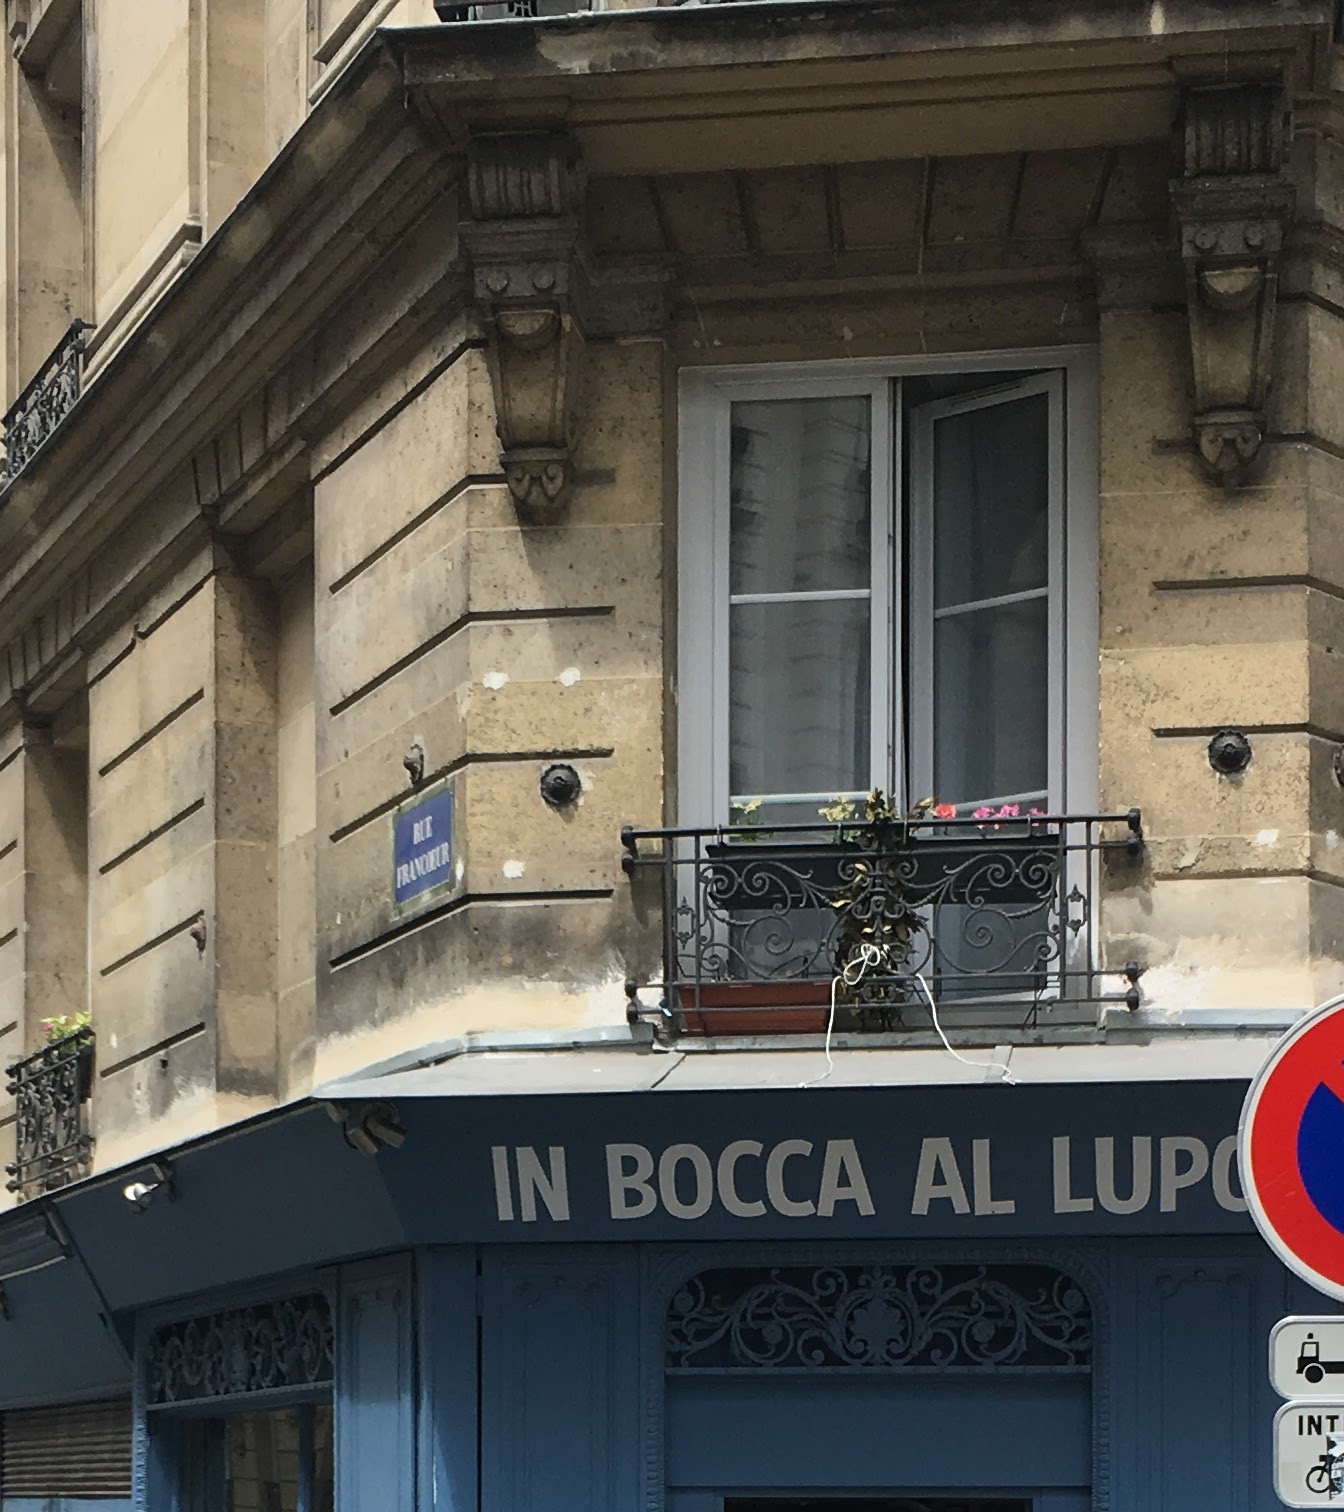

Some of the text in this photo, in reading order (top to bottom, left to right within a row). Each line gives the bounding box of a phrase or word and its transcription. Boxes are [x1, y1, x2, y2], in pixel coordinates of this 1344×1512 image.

[412, 815, 433, 845] RUE
[491, 1135, 1249, 1222] IN BOCCA AL LUPO
